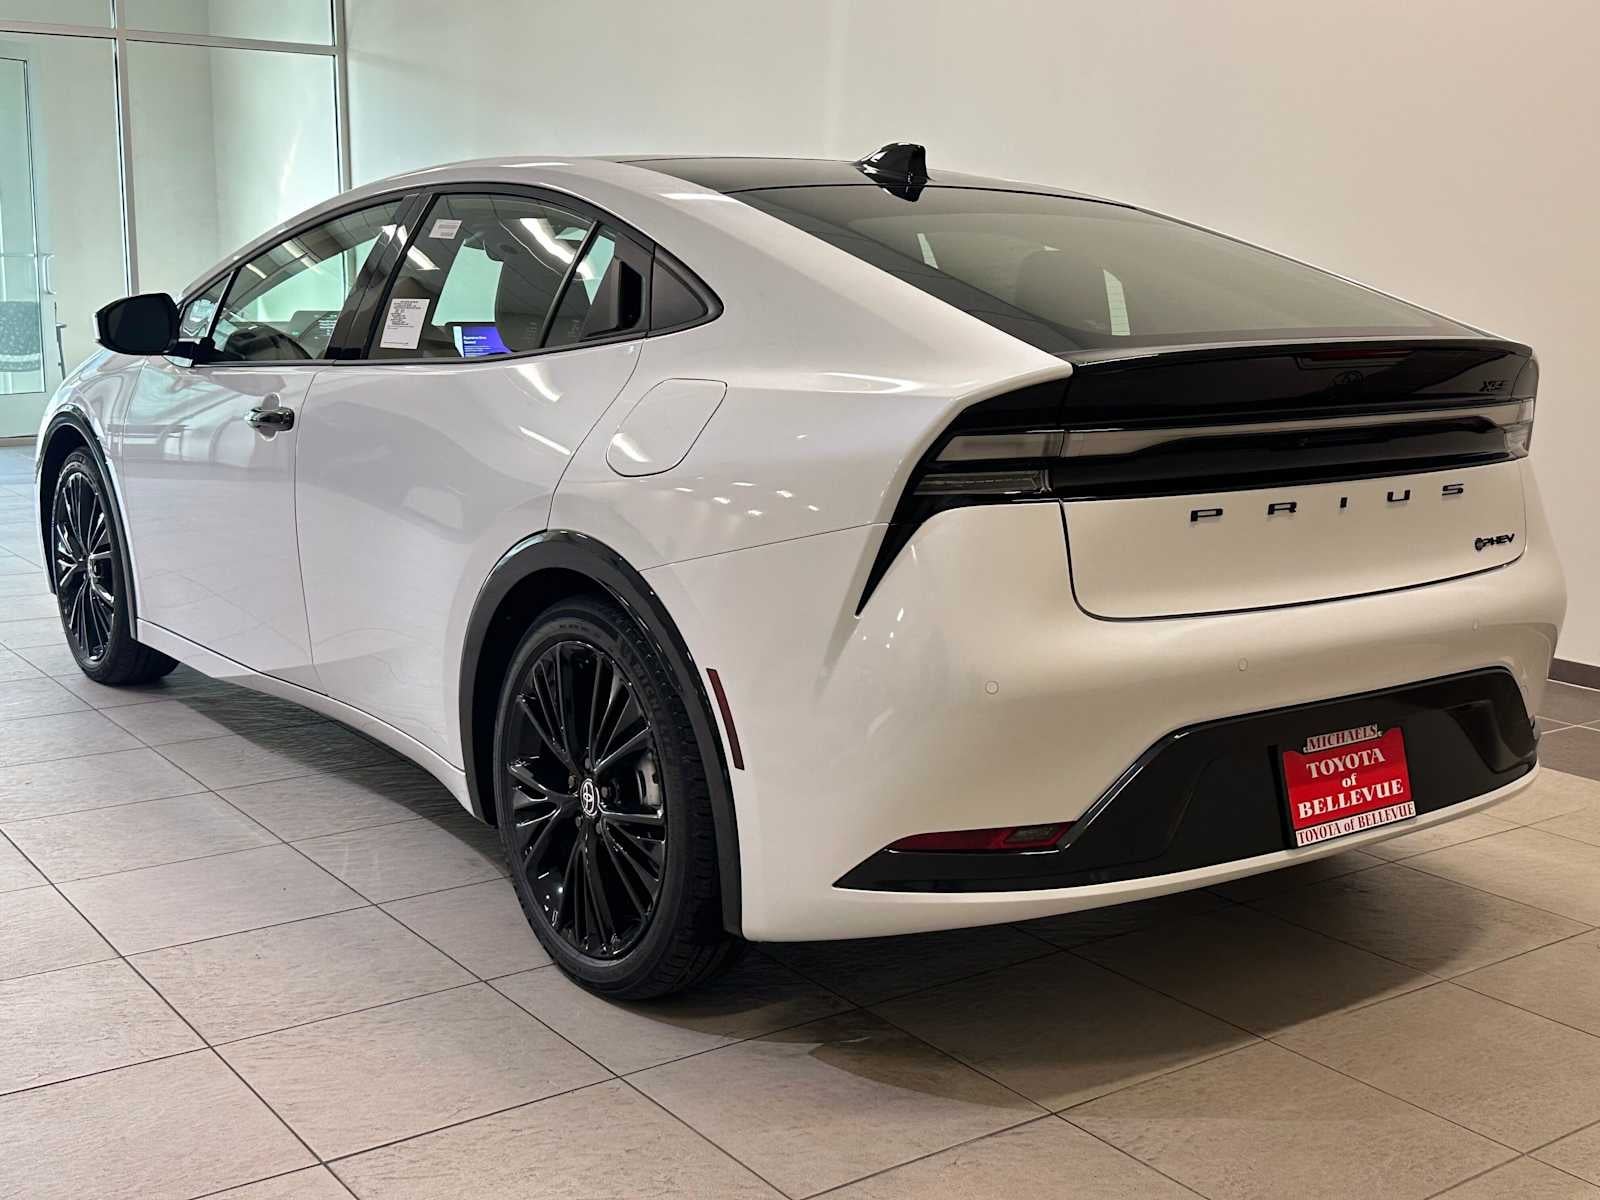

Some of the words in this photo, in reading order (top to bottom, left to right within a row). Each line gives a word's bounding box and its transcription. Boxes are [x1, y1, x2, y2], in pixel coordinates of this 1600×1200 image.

[1190, 483, 1464, 522] PRIUS
[1306, 748, 1386, 779] TOYOTA
[1342, 773, 1357, 788] of
[1297, 779, 1404, 819] BELLEVUE
[1297, 824, 1341, 844] TOYOTA
[1344, 818, 1355, 832] of
[1359, 803, 1415, 829] BELLEVUE
